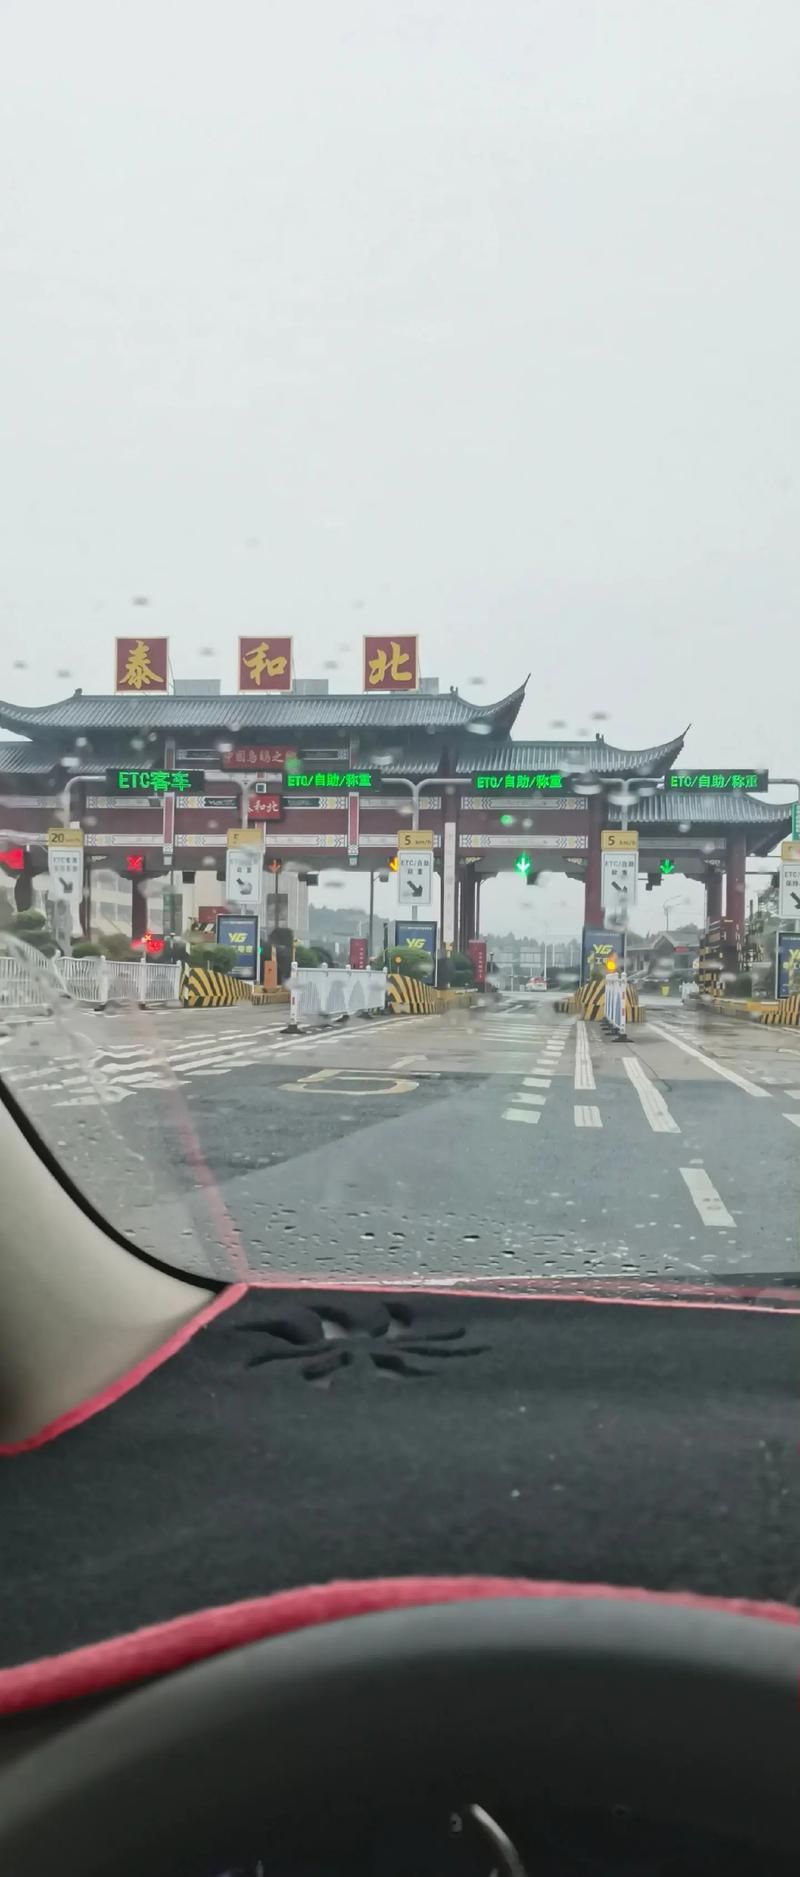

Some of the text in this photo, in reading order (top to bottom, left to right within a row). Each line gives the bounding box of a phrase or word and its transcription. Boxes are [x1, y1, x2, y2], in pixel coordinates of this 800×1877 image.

[119, 640, 413, 688] 泰和北
[118, 771, 191, 792] ETC客车
[51, 833, 64, 843] 20
[404, 835, 411, 845] 5
[608, 836, 615, 846] 5
